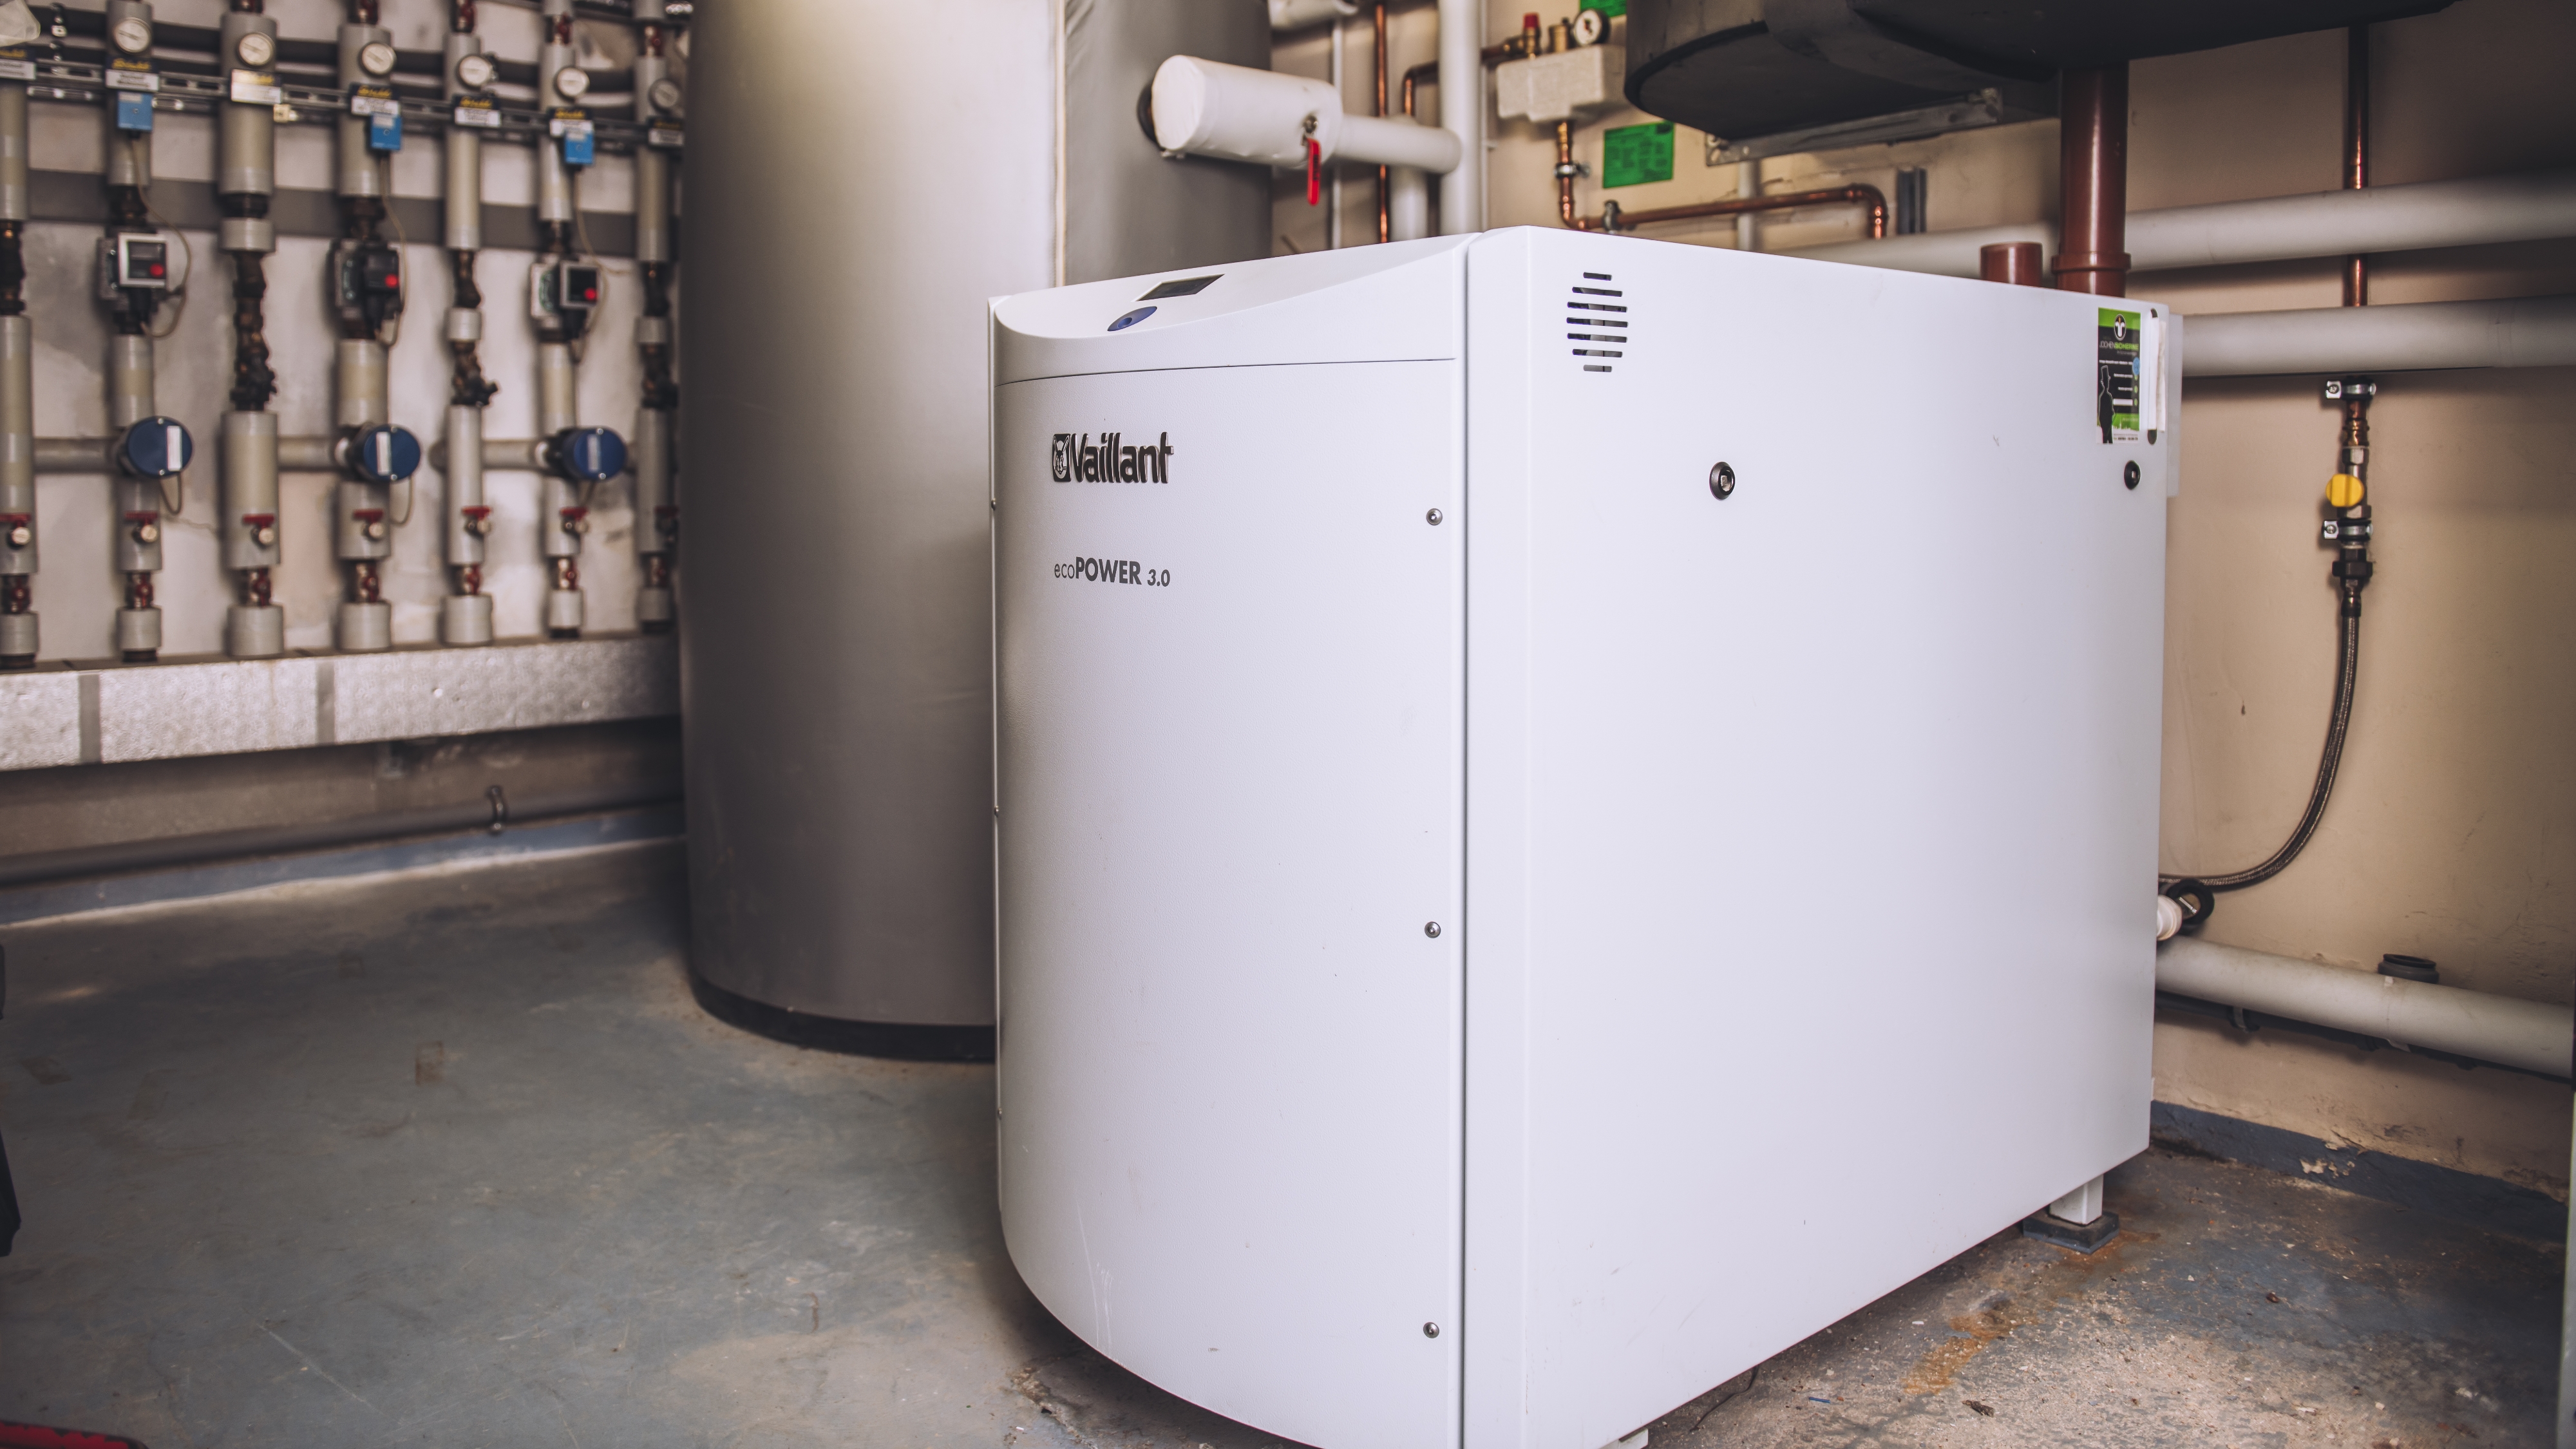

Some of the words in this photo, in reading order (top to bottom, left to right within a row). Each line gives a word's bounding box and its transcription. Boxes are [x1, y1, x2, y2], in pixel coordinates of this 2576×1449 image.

[1071, 431, 1174, 484] Vaillant
[1054, 556, 1142, 585] ecoPOWER
[1147, 569, 1171, 587] 3.0
